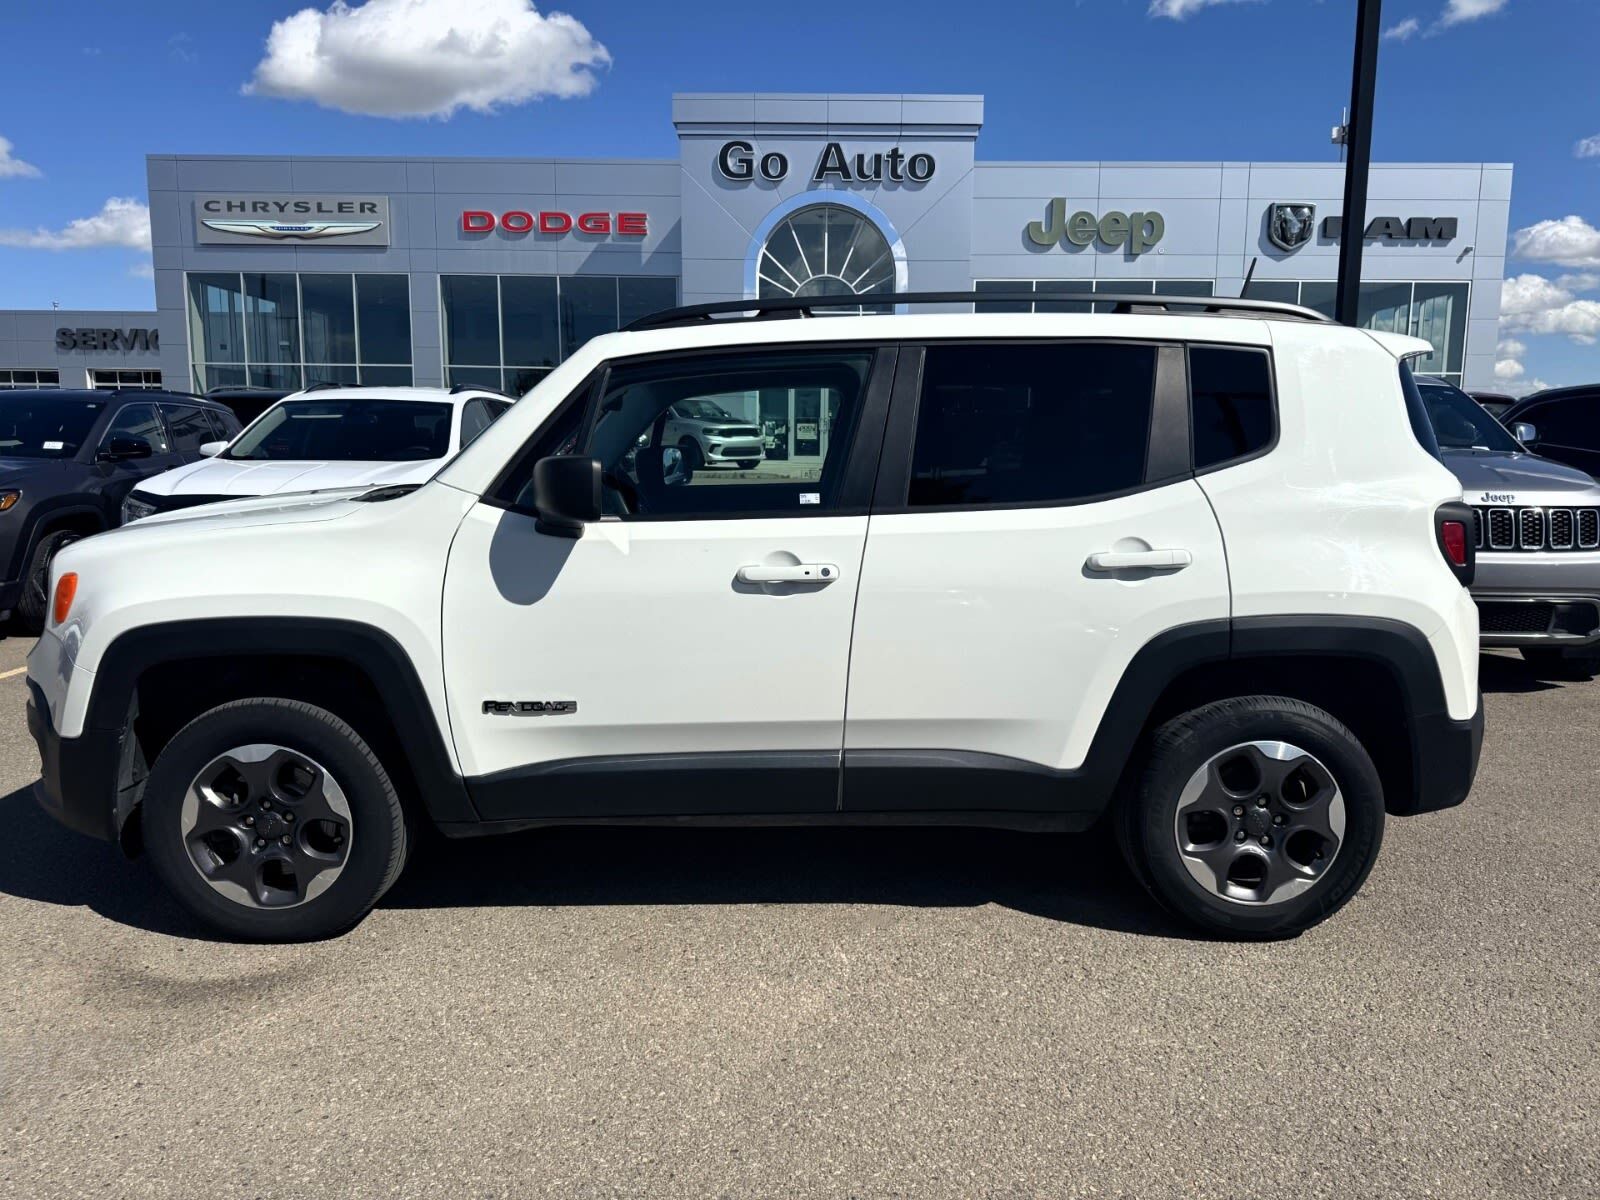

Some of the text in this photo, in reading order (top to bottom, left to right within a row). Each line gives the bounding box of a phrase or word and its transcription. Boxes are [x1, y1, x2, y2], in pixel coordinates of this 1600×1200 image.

[718, 140, 936, 182] Go Auto
[203, 200, 378, 214] CHRYSLER
[462, 210, 648, 235] DODGE
[1028, 197, 1165, 254] Jeep
[1481, 492, 1515, 504] Jeep
